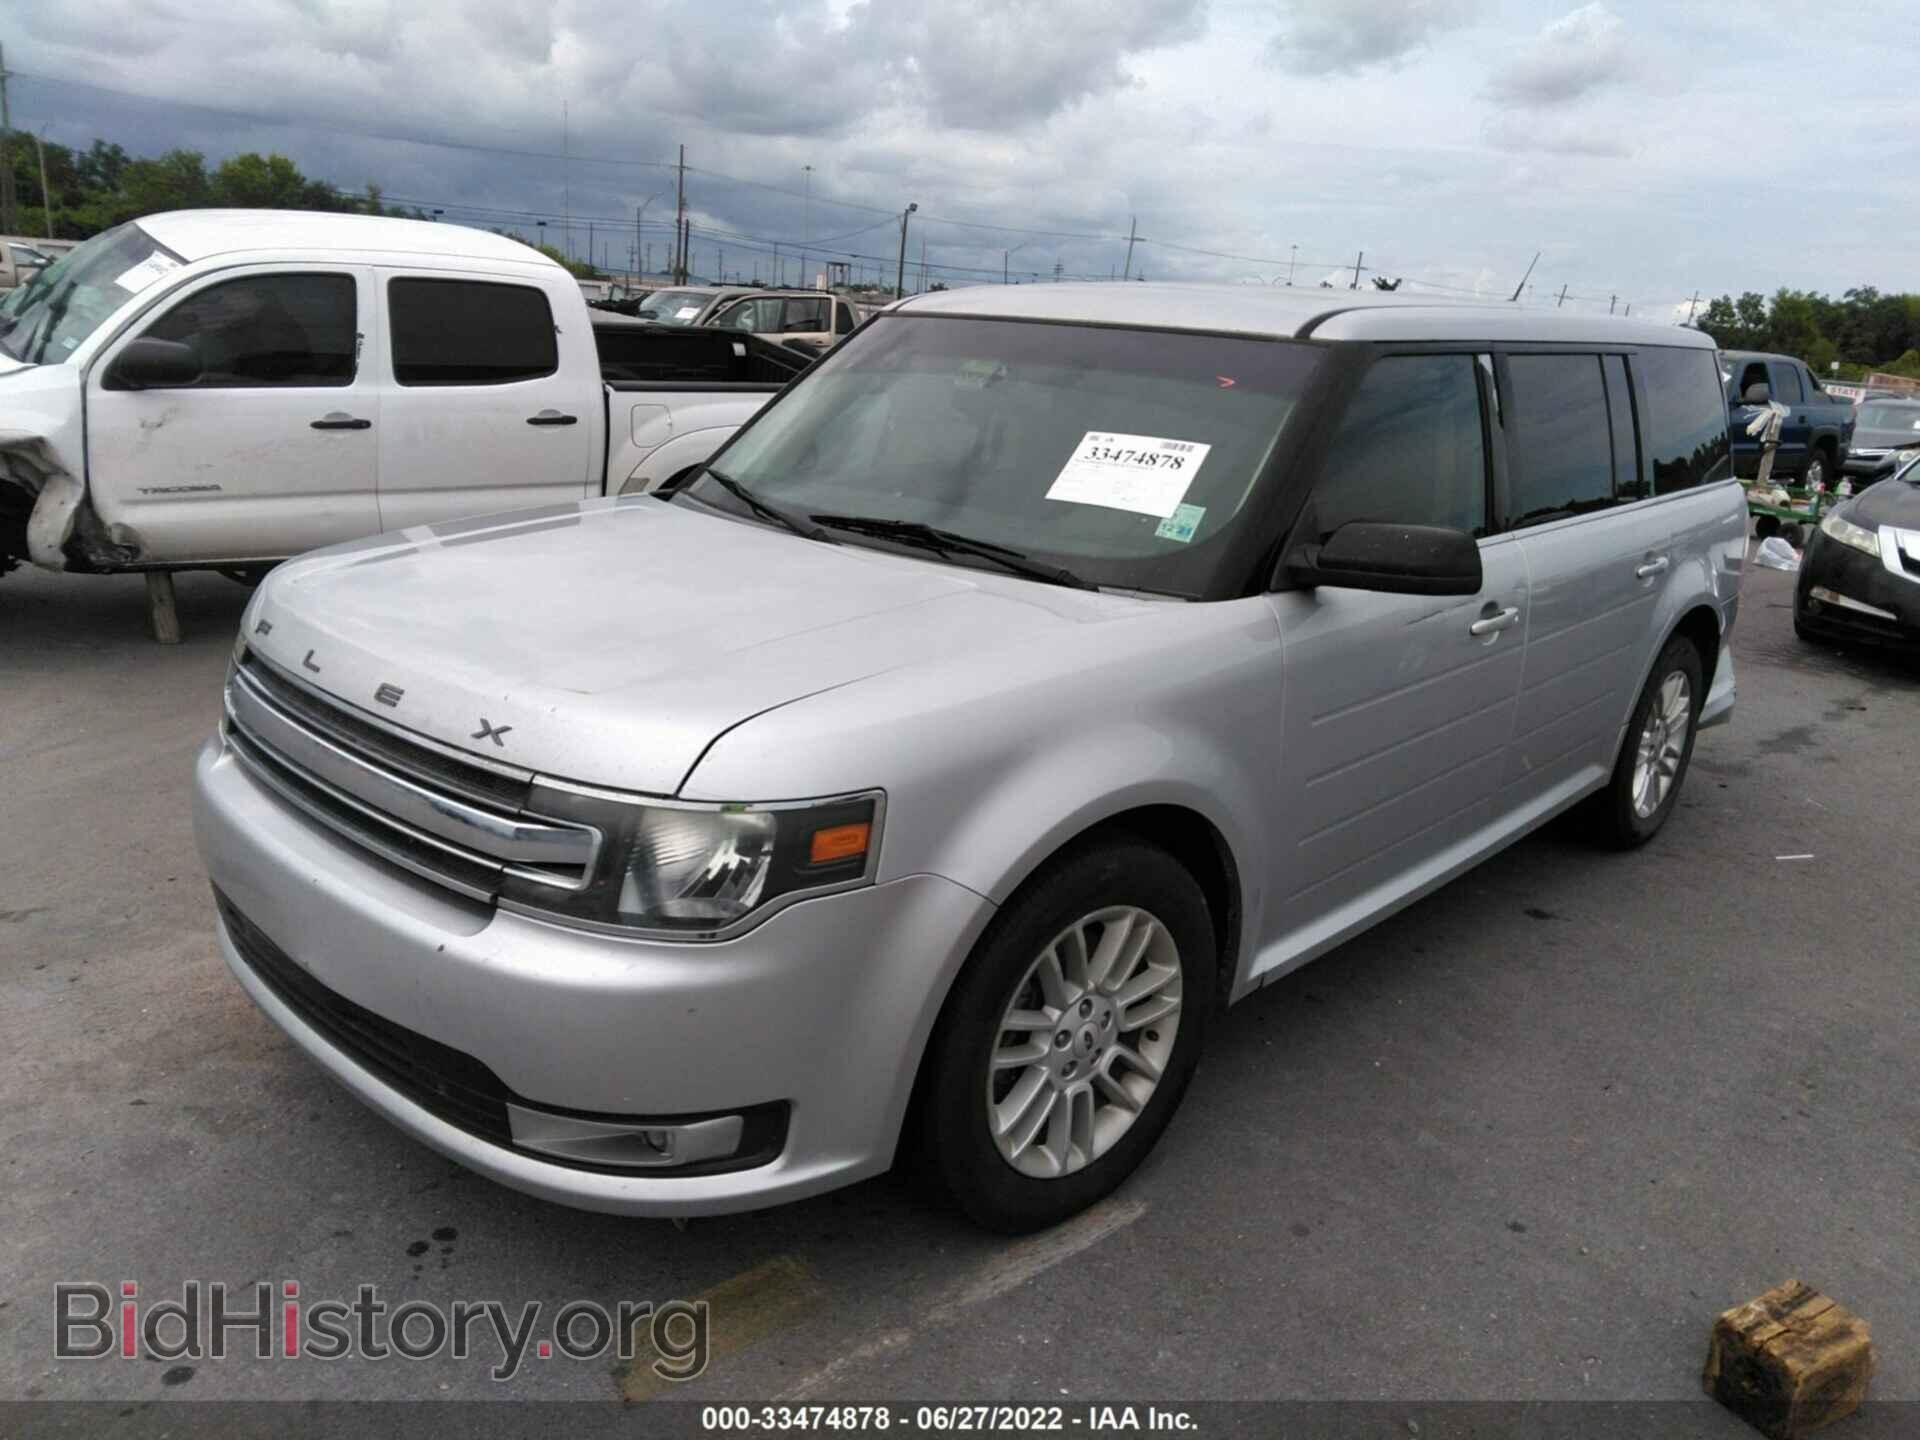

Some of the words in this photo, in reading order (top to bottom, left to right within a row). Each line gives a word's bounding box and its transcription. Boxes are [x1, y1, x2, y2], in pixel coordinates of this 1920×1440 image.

[1083, 446, 1185, 470] 33474878
[136, 484, 222, 495] TACOMA
[254, 618, 513, 748] FLEX
